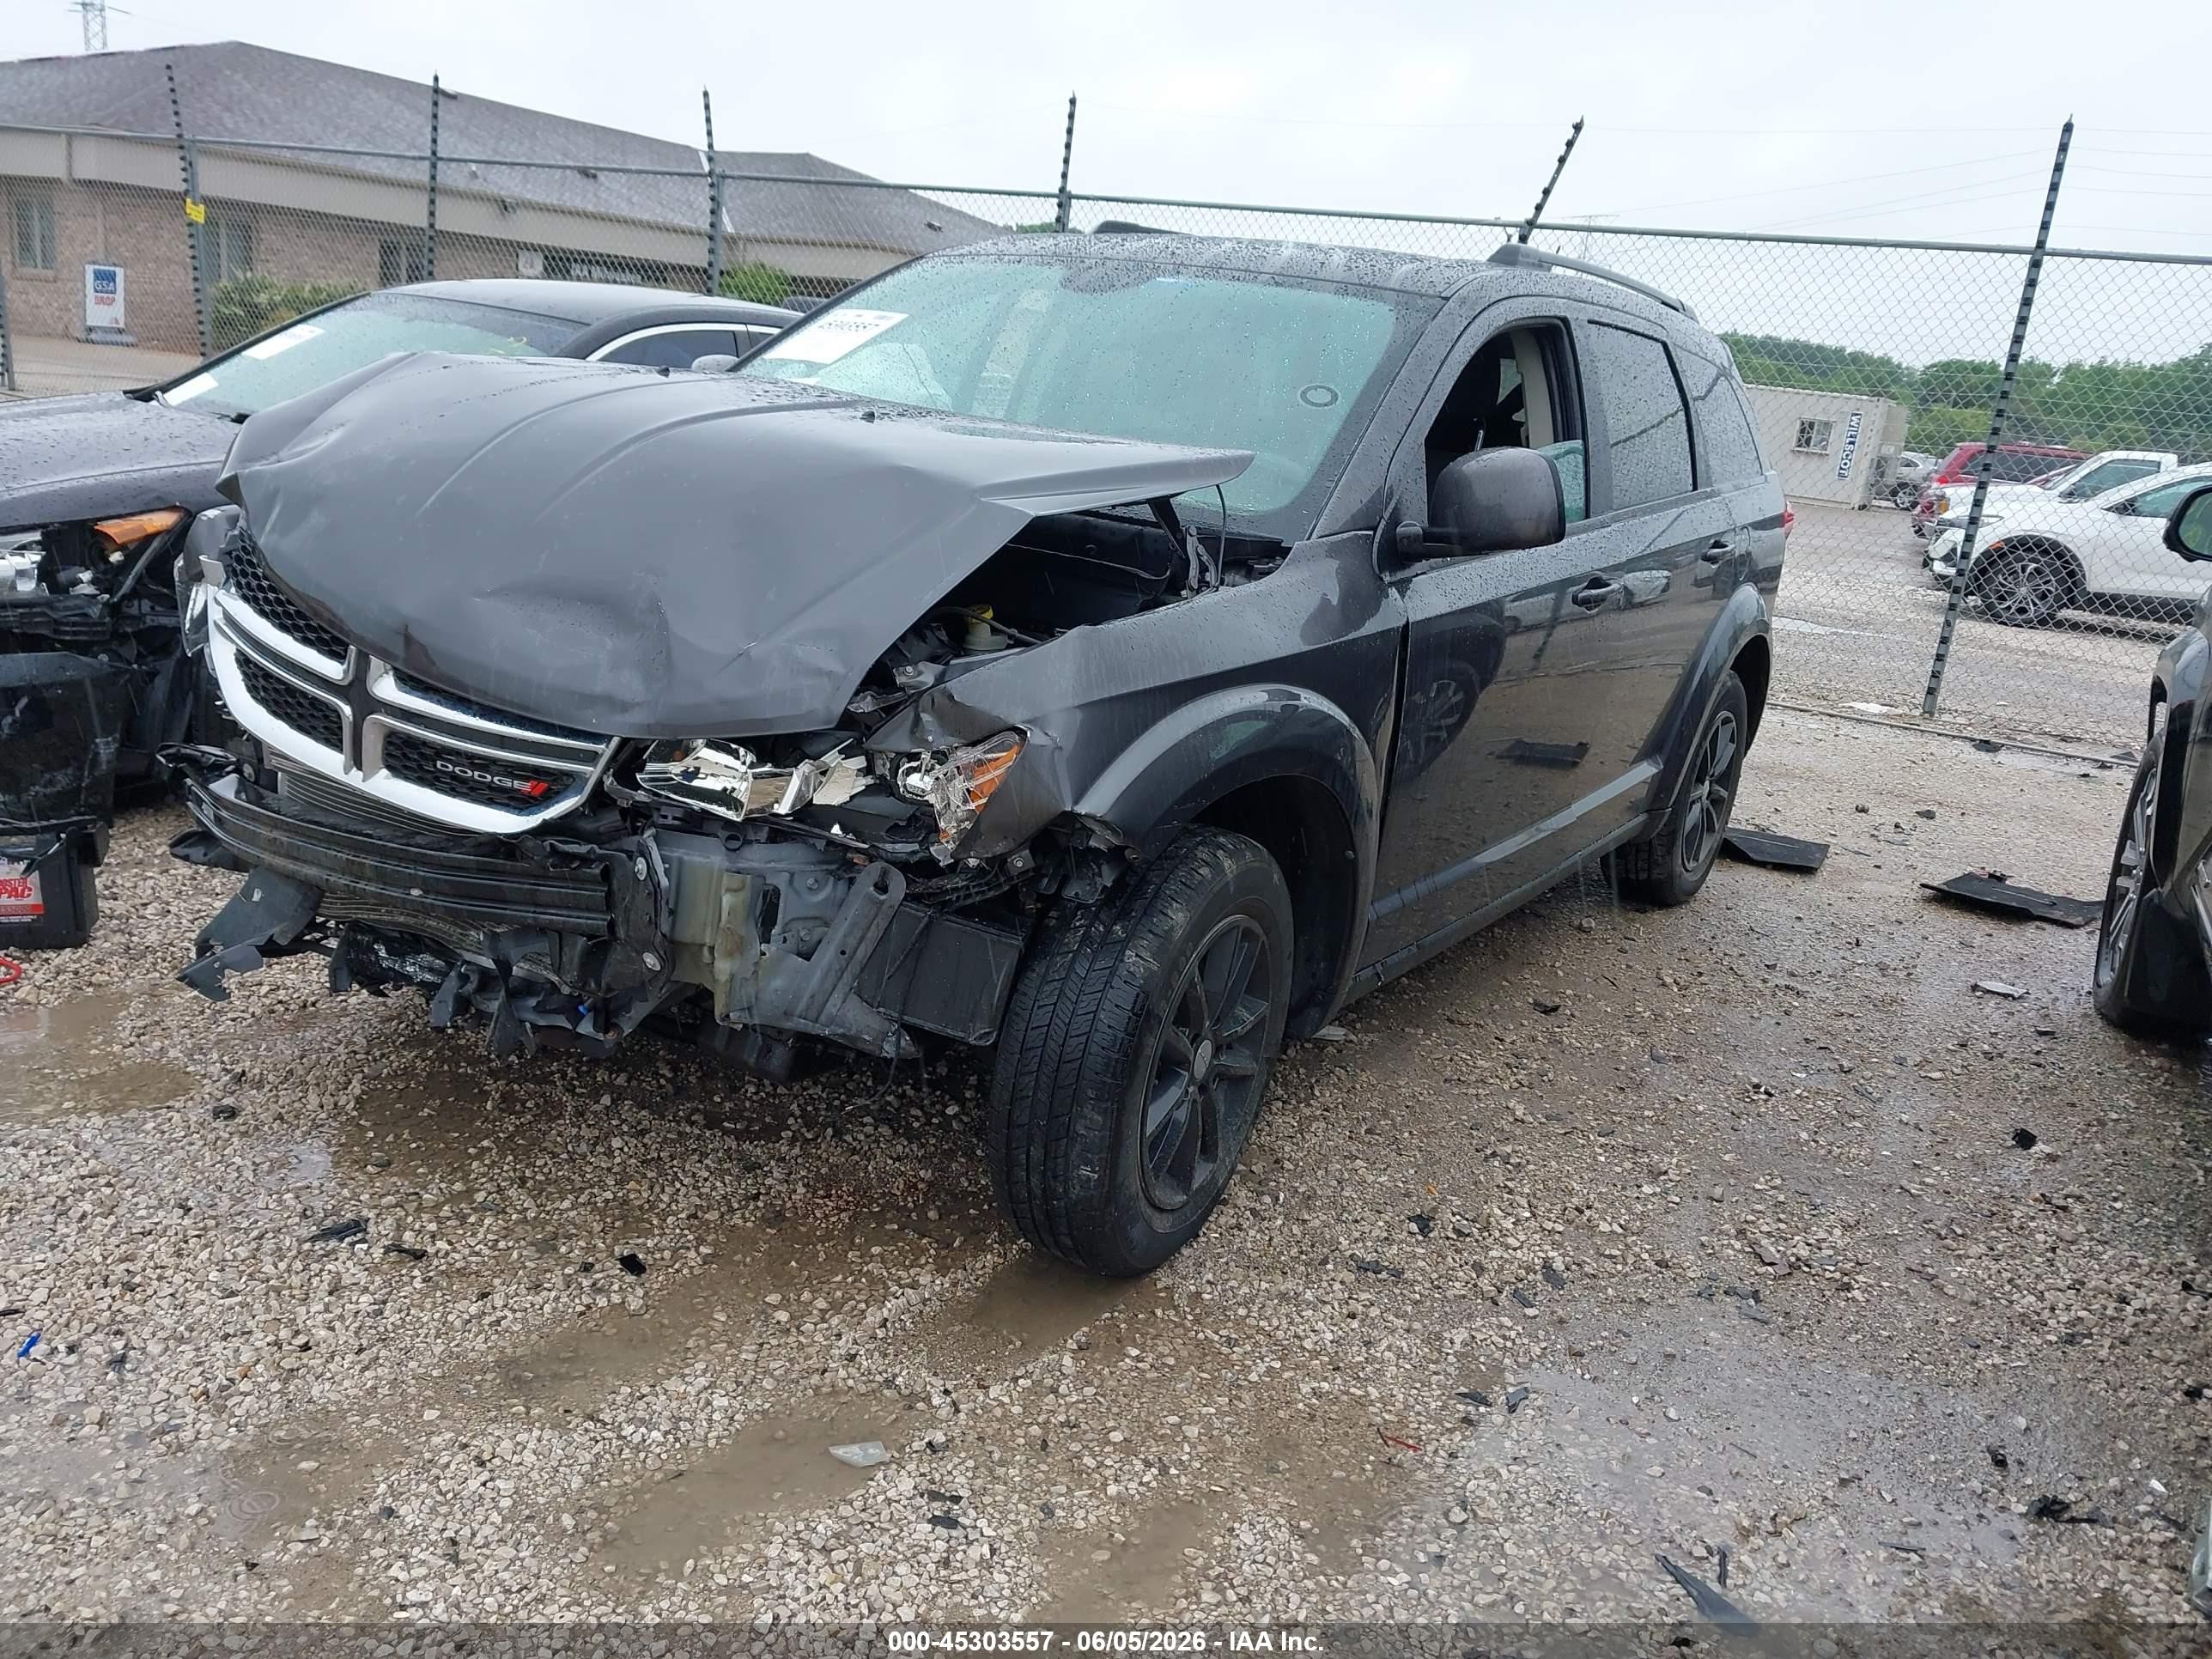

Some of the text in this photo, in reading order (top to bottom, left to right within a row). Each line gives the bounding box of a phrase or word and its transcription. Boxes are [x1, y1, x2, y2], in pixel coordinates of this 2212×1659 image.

[94, 281, 116, 291] GSA
[1839, 414, 1863, 477] WILLSCOT
[435, 760, 533, 792] DODGE
